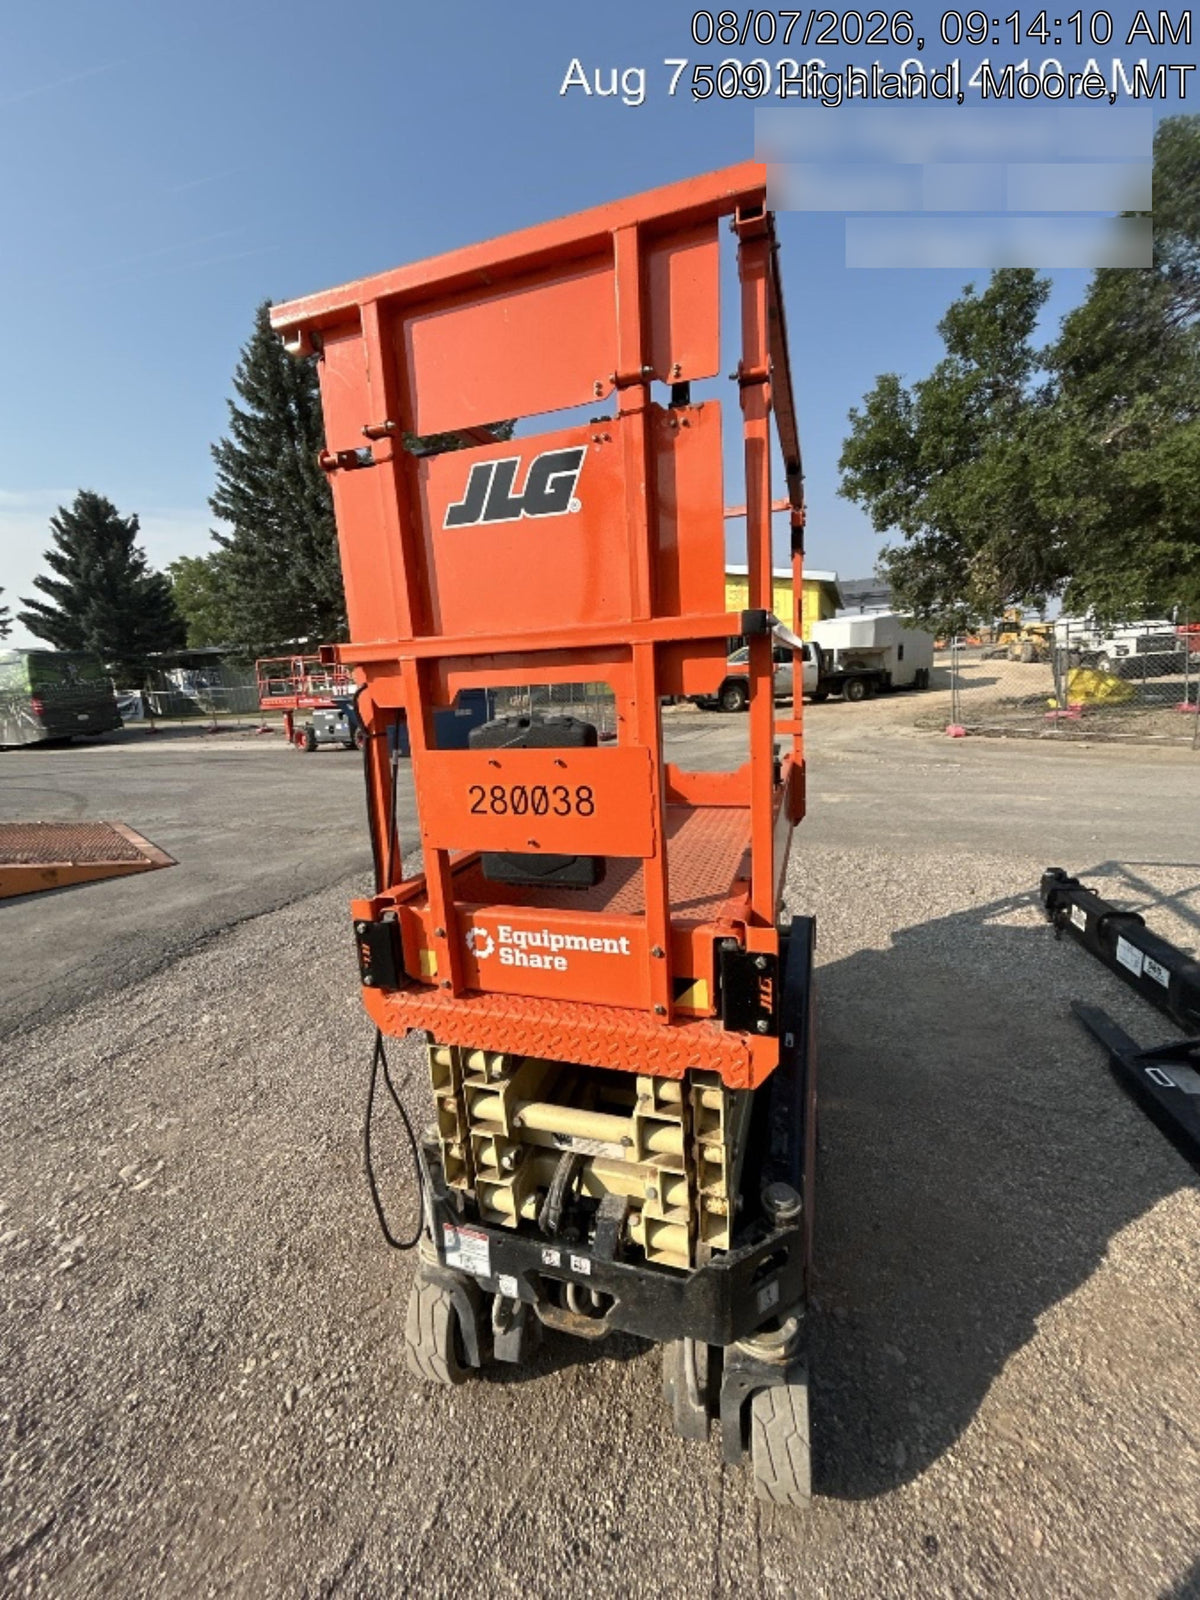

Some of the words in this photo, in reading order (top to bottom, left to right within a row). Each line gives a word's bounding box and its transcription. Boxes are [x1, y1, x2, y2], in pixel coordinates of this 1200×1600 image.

[443, 445, 588, 529] JLG
[468, 785, 595, 817] 280038
[497, 925, 631, 955] Equipment
[499, 947, 568, 971] Share
